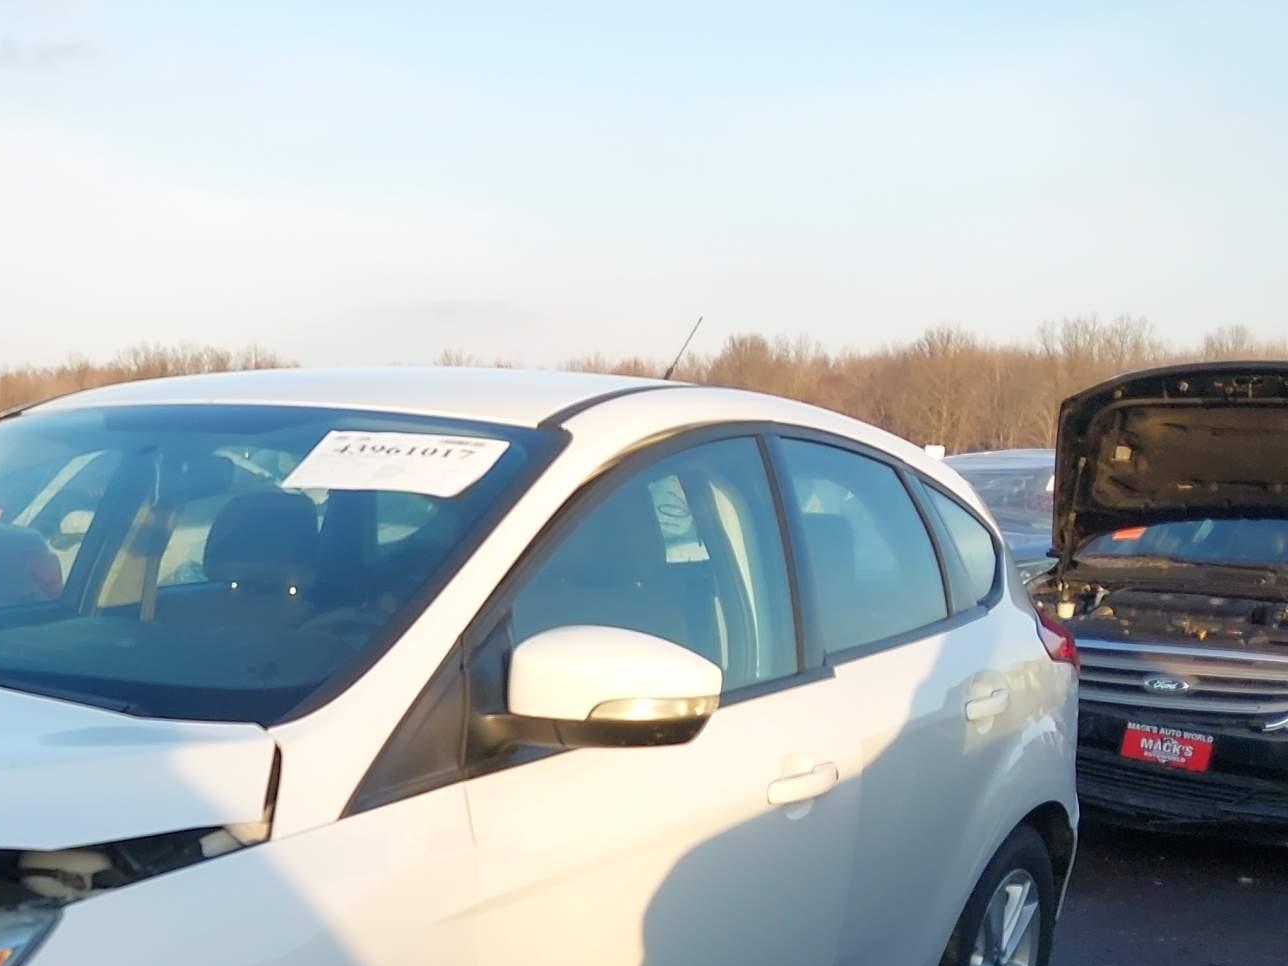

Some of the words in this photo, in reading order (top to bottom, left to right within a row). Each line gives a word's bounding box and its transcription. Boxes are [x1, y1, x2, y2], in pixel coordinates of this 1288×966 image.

[1158, 727, 1182, 737] AUTO
[1183, 732, 1214, 743] WORLD
[1140, 737, 1194, 757] MACK'S
